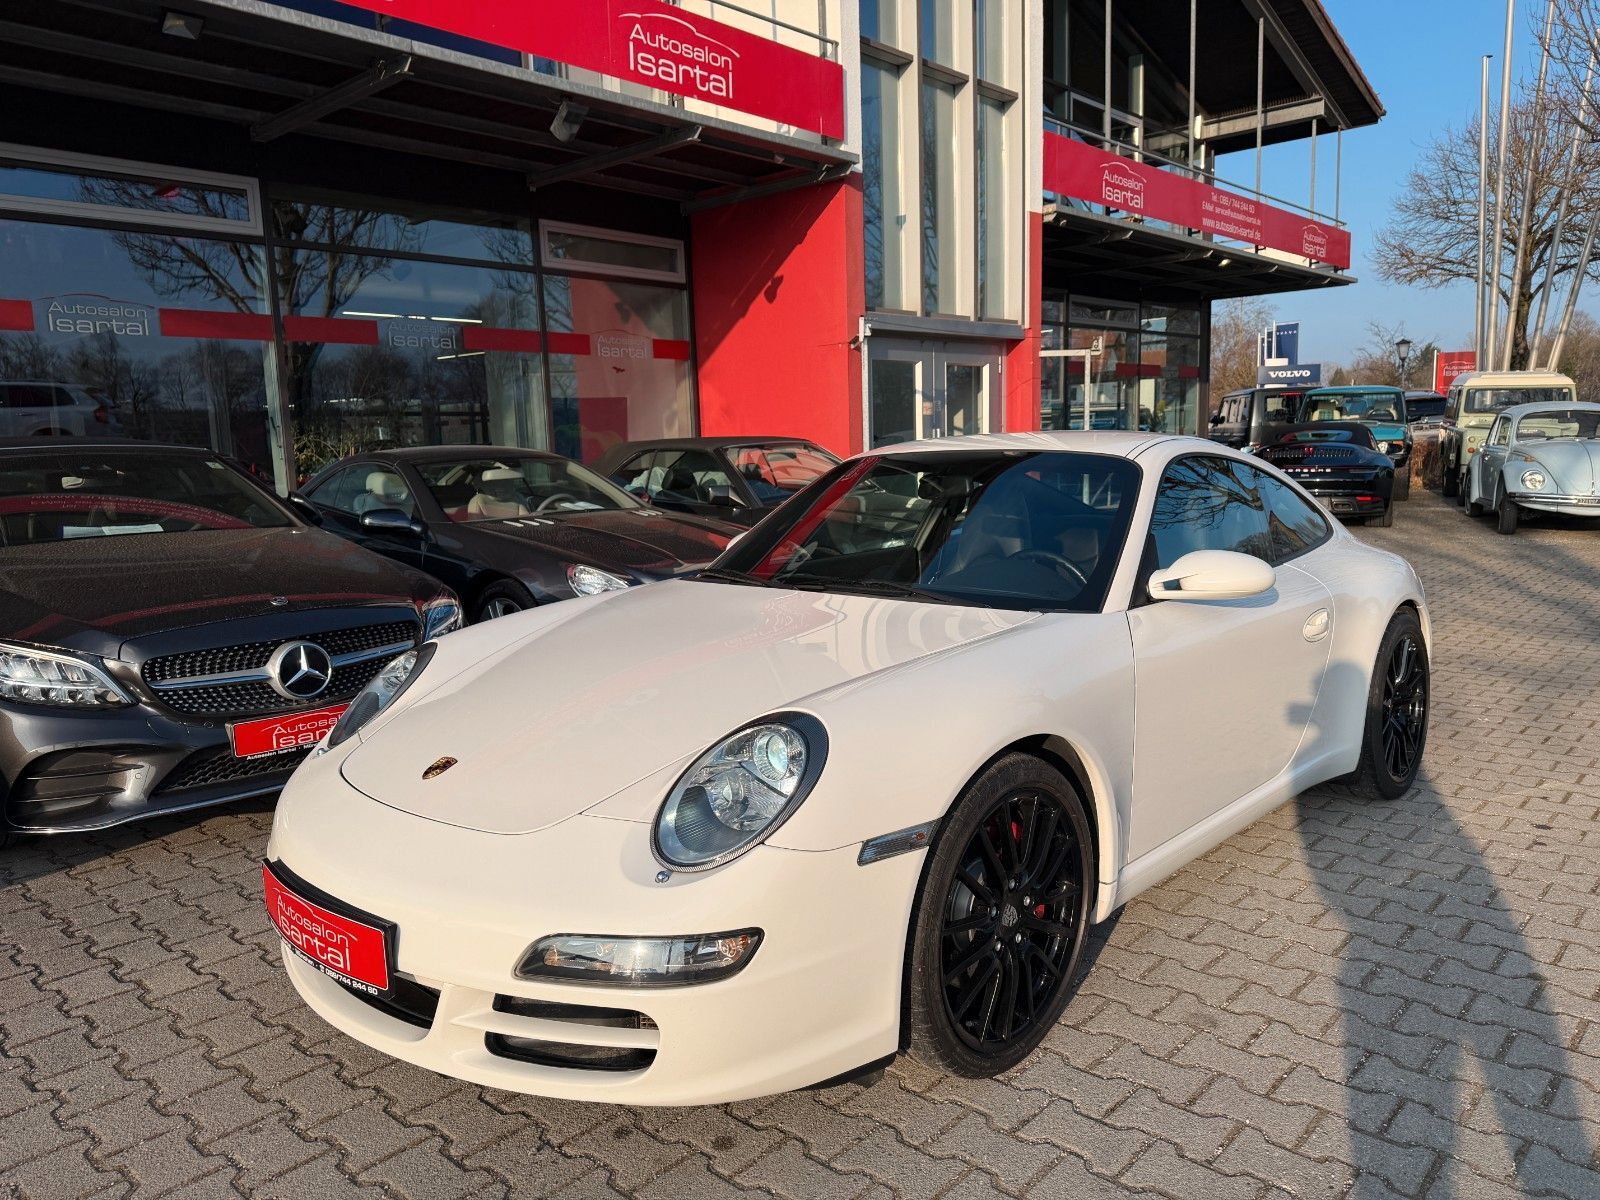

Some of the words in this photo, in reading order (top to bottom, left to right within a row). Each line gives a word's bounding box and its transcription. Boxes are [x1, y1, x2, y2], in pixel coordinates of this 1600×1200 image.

[629, 23, 733, 71] Autosalon
[629, 41, 733, 99] Isartal
[1103, 169, 1144, 191] Autosalon
[1102, 180, 1144, 209] Isartal
[1202, 217, 1261, 240] www.autosalon-isartal.de
[1303, 230, 1327, 246] Autosalon
[1303, 240, 1327, 258] Isartal
[48, 301, 147, 319] Autosalon
[48, 313, 149, 336] Isartal
[388, 321, 456, 335] Autosalon
[388, 330, 457, 350] Isartal
[597, 342, 648, 360] Isartal
[1268, 369, 1311, 379] VOLVO
[273, 714, 342, 735] Autosal
[272, 726, 333, 749] Isar
[246, 751, 277, 760] Autosalon
[277, 747, 297, 755] Isartal
[277, 894, 349, 948] Autosalon
[278, 903, 351, 972] Isartal
[352, 980, 367, 992] 244
